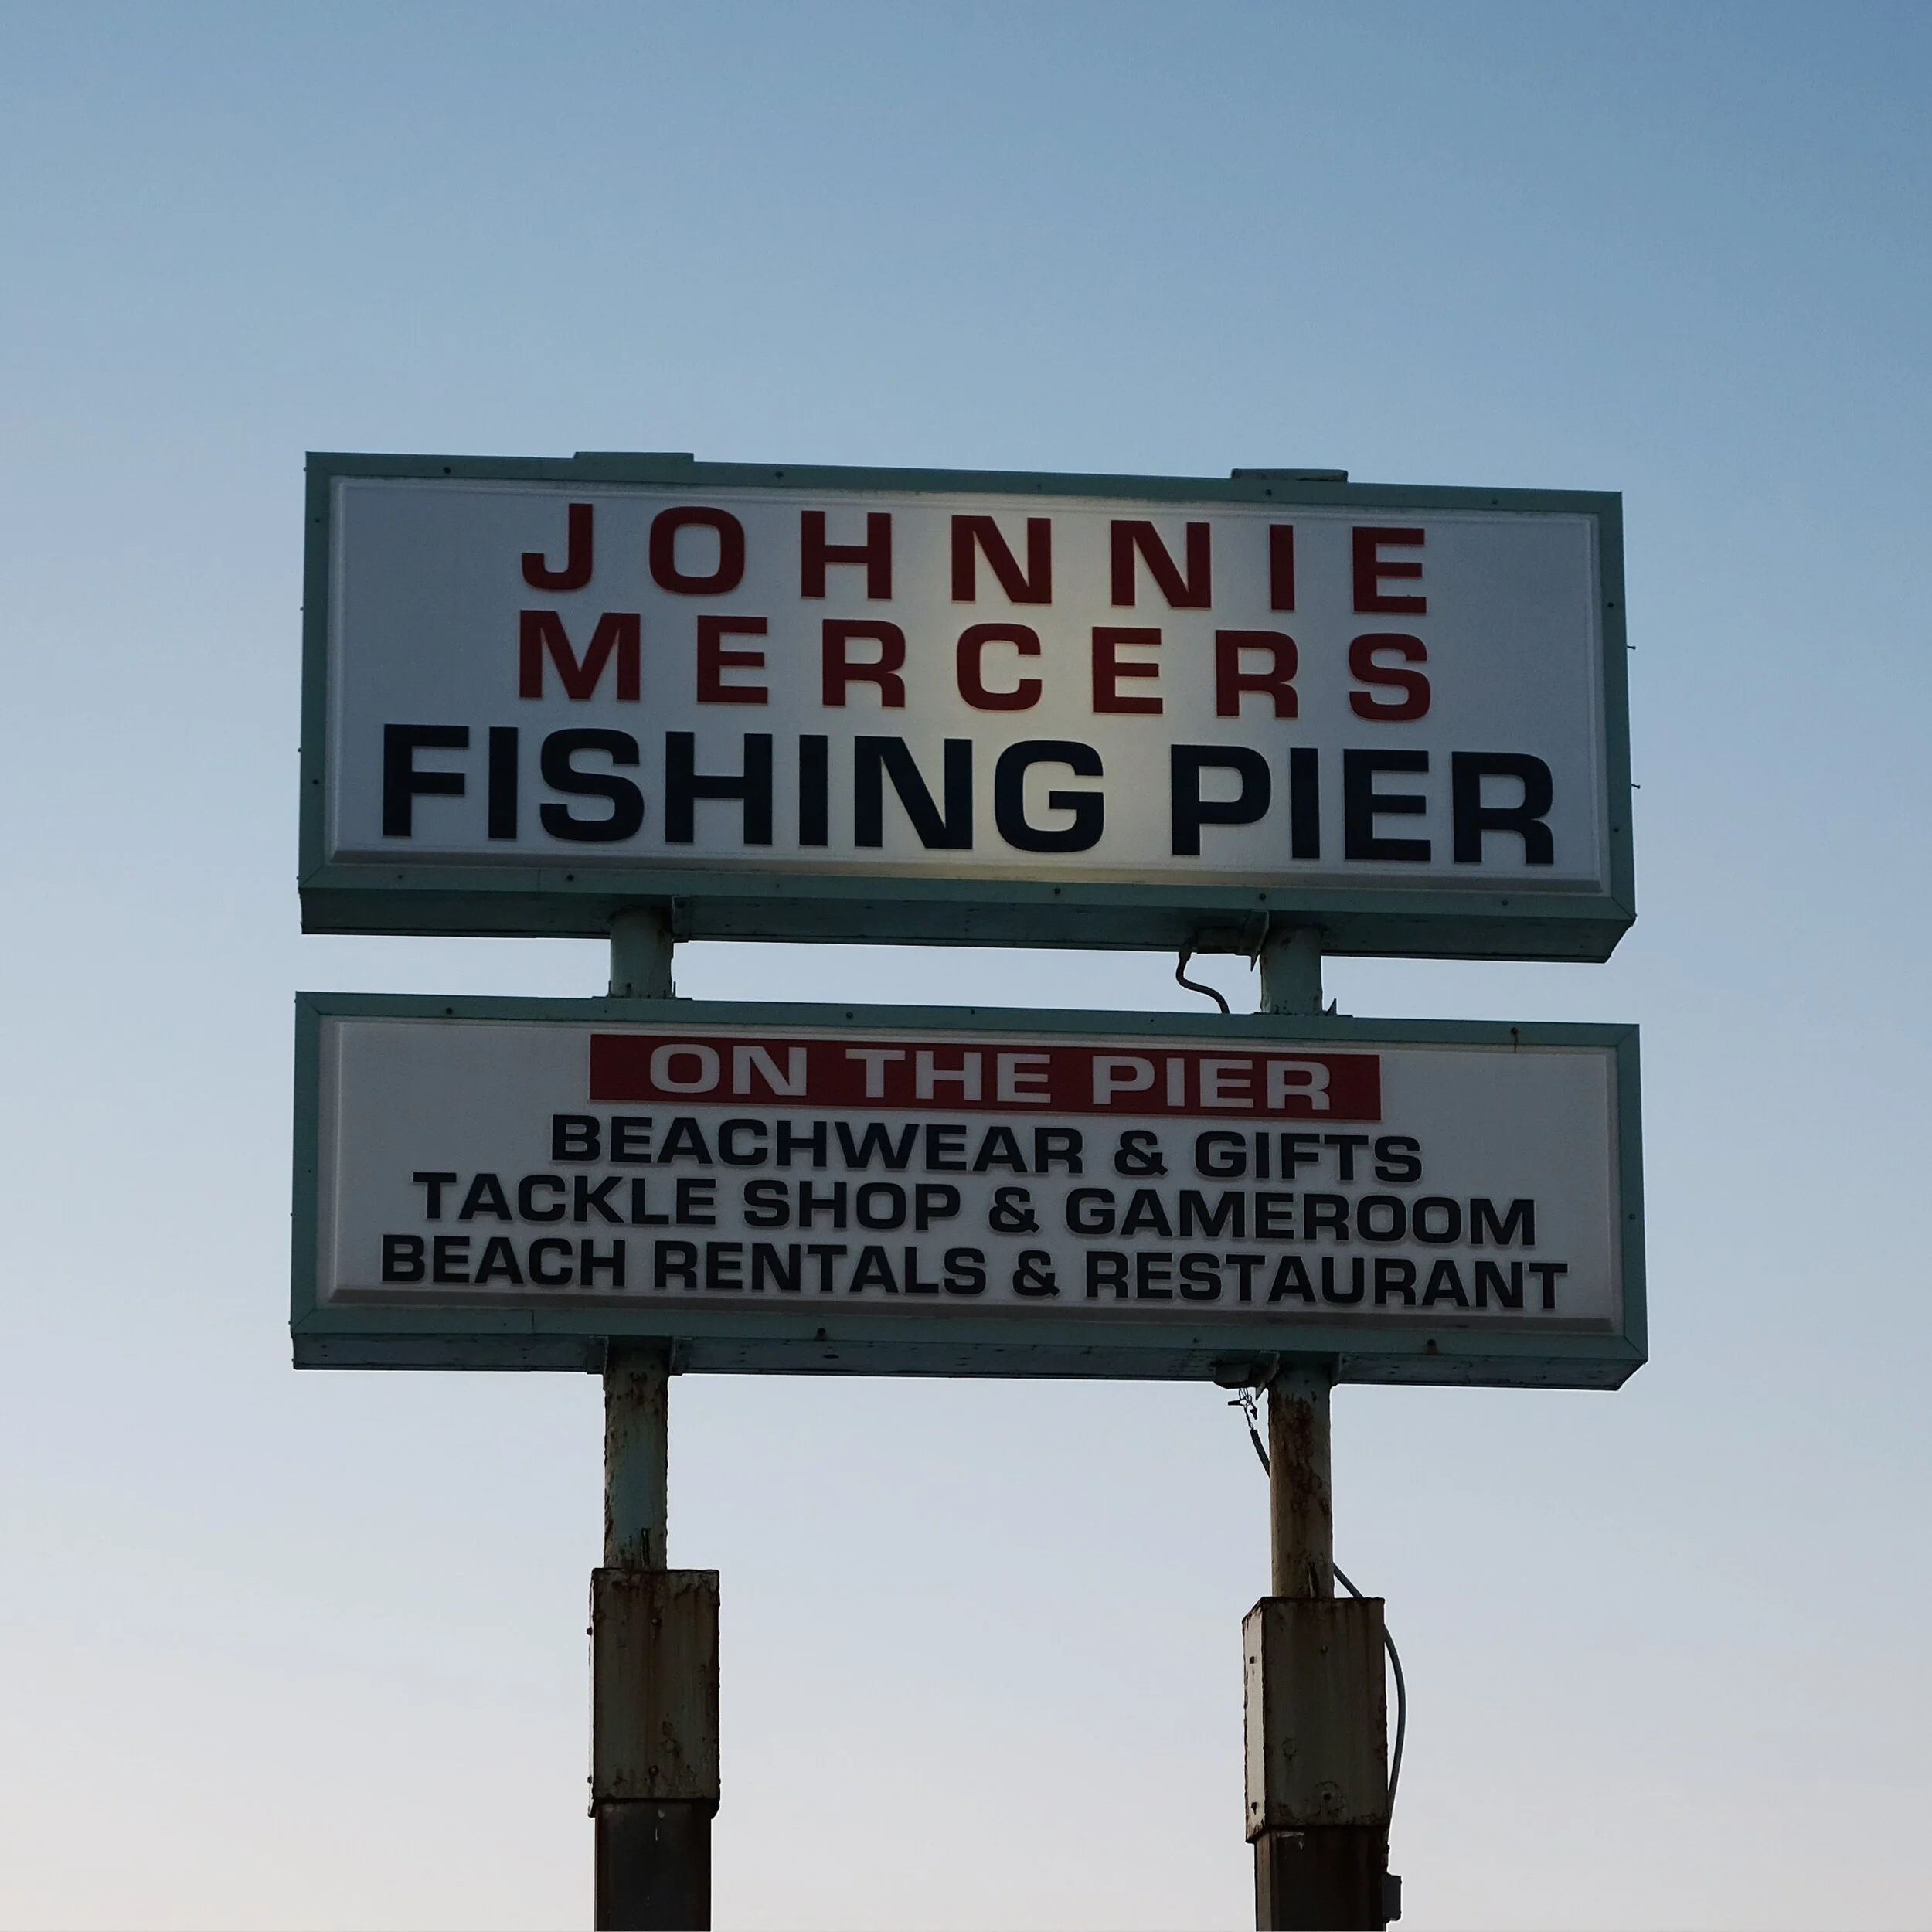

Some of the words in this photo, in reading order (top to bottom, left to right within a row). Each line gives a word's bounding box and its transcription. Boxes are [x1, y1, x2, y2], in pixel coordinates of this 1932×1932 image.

[521, 503, 1427, 614] JOHNNIE
[519, 610, 1430, 722] MERCERS
[383, 723, 1104, 853] FISHING
[1171, 743, 1554, 864] PIER
[650, 1043, 807, 1096] ON
[845, 1049, 1052, 1104] THE
[1092, 1056, 1331, 1110] PIER
[552, 1114, 1083, 1173] BEACHWEAR
[1114, 1131, 1168, 1175] &
[1196, 1131, 1422, 1182] GIFTS
[413, 1172, 716, 1225] TACKLE
[743, 1180, 961, 1230] SHOP
[989, 1187, 1039, 1232] &
[1066, 1188, 1536, 1245] GAMEROOM
[382, 1235, 625, 1286] BEACH
[655, 1242, 986, 1294] RENTALS
[1013, 1250, 1060, 1296] &
[1086, 1251, 1567, 1309] RESTAURANT
